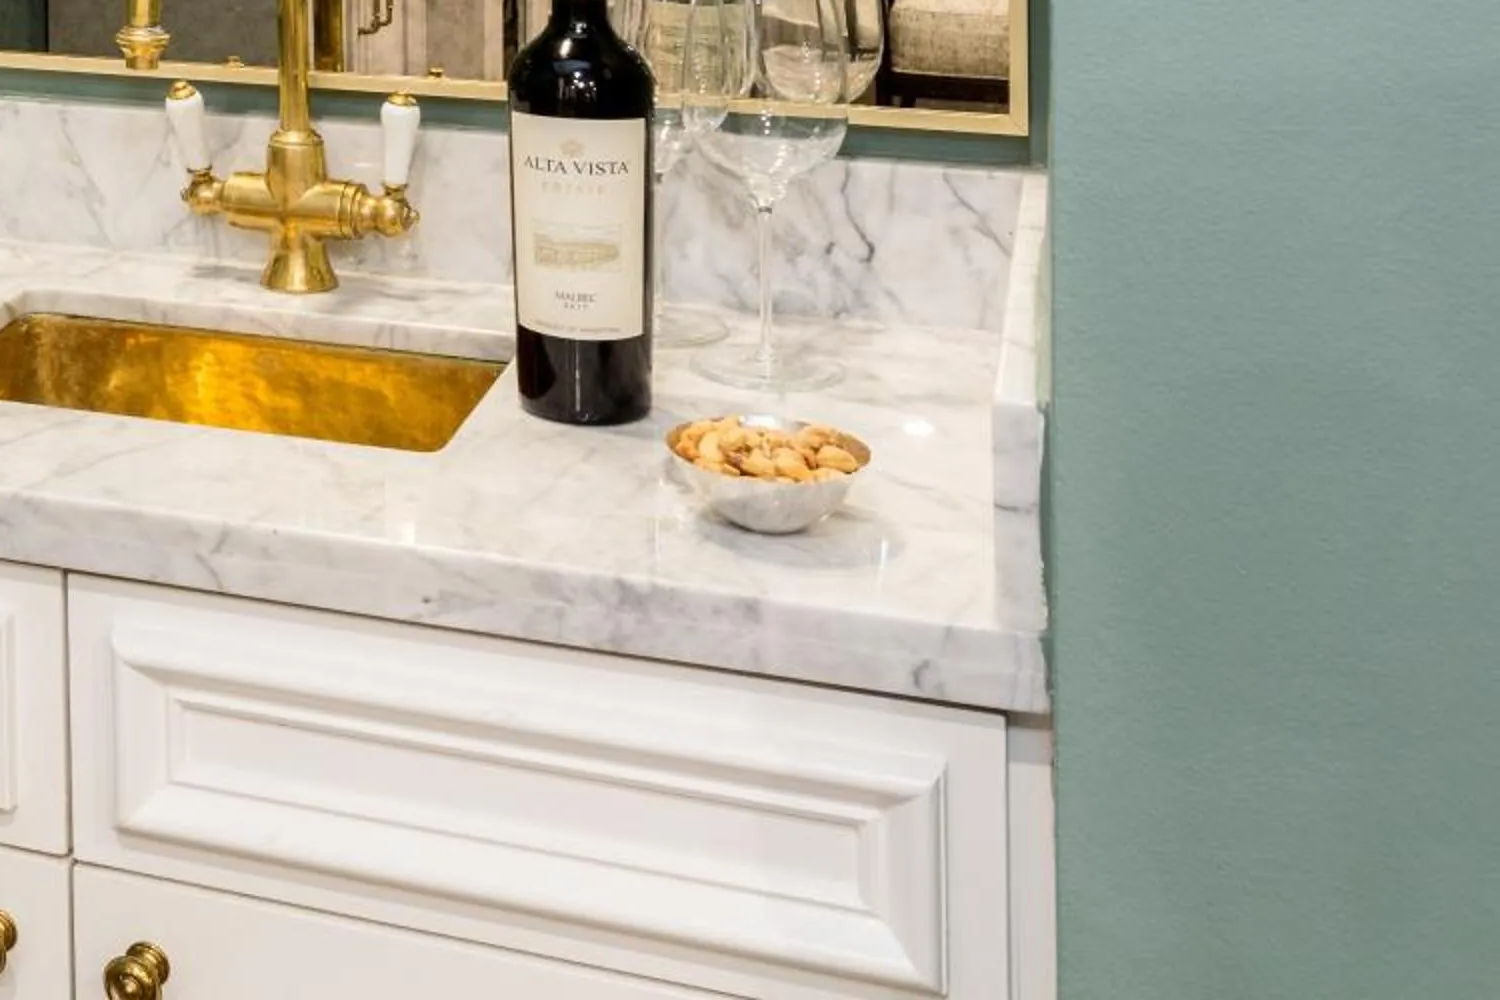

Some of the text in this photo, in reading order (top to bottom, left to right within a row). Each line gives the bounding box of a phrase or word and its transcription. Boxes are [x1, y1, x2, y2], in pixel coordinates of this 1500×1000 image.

[523, 155, 630, 176] ALTA VISTA
[555, 290, 597, 303] MALBEC
